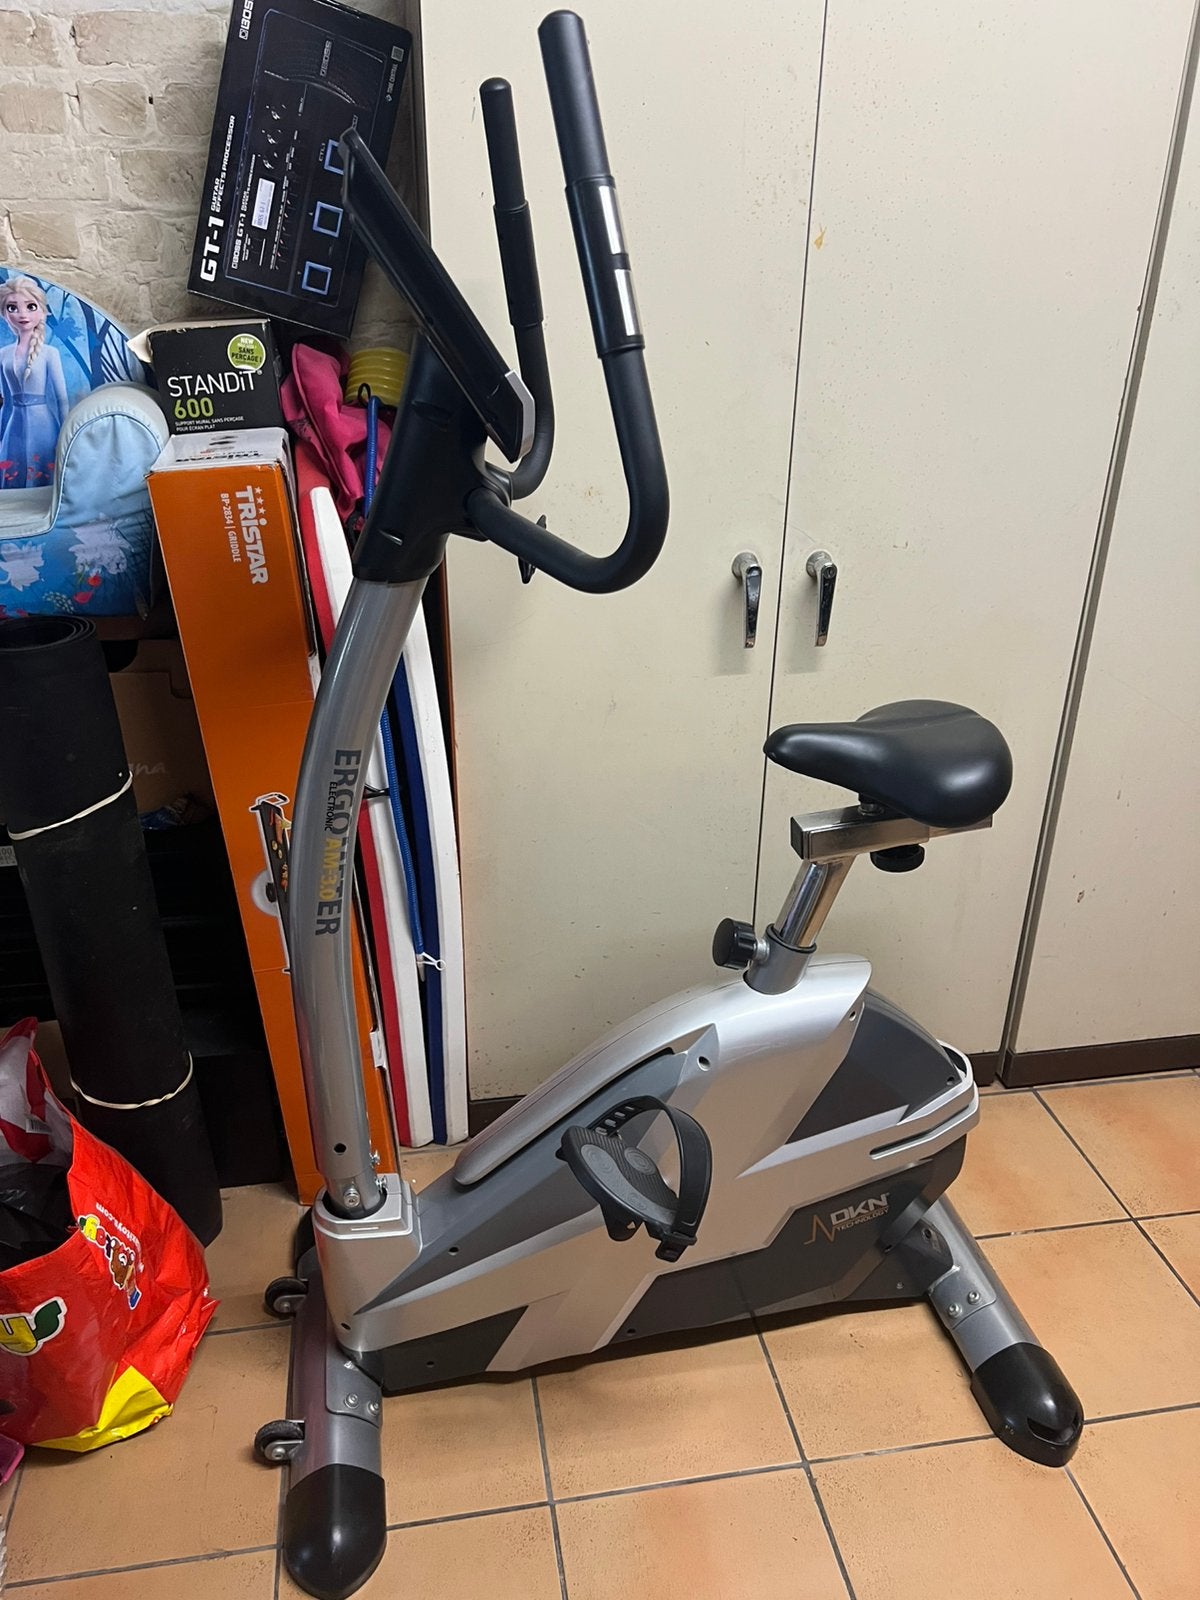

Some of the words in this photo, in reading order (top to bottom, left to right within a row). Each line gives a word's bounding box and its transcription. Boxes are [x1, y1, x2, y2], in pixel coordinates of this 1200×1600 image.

[215, 171, 227, 213] EFFECTS
[222, 115, 235, 171] PROCESSOR
[211, 177, 220, 212] GUITAR
[200, 216, 225, 282] GT-1
[174, 397, 214, 419] 600
[220, 492, 235, 525] BP-2834
[227, 530, 242, 563] GRIDDLE
[324, 781, 338, 832] ELECTRONIC
[830, 1193, 889, 1226] DKN
[837, 1205, 890, 1231] TECHNOLOGY
